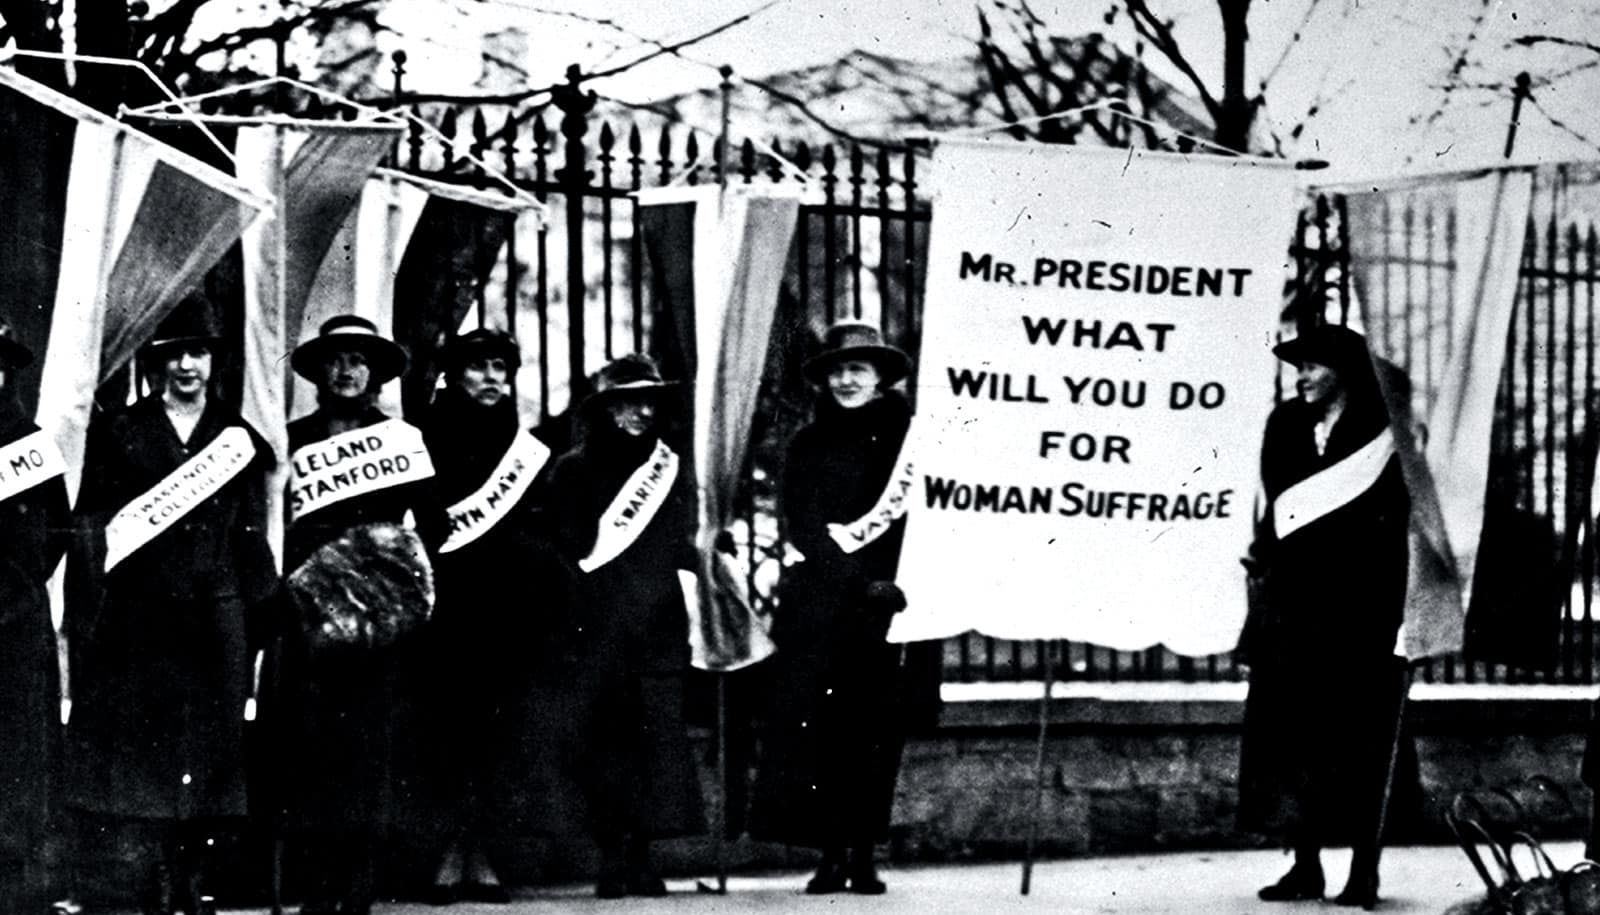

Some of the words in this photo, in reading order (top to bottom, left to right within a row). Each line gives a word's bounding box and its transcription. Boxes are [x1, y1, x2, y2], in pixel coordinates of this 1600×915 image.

[1033, 257, 1252, 297] PRESIDENT
[1022, 315, 1176, 352] WHAT
[947, 366, 1049, 403] WILL
[1063, 375, 1147, 408] YOU
[1169, 381, 1226, 410] DO
[294, 436, 383, 478] LELAND
[1039, 431, 1131, 464] FOR
[292, 454, 411, 512] STANFORD
[924, 475, 1053, 513] WOMAN
[1059, 482, 1234, 521] SUFFRAGE
